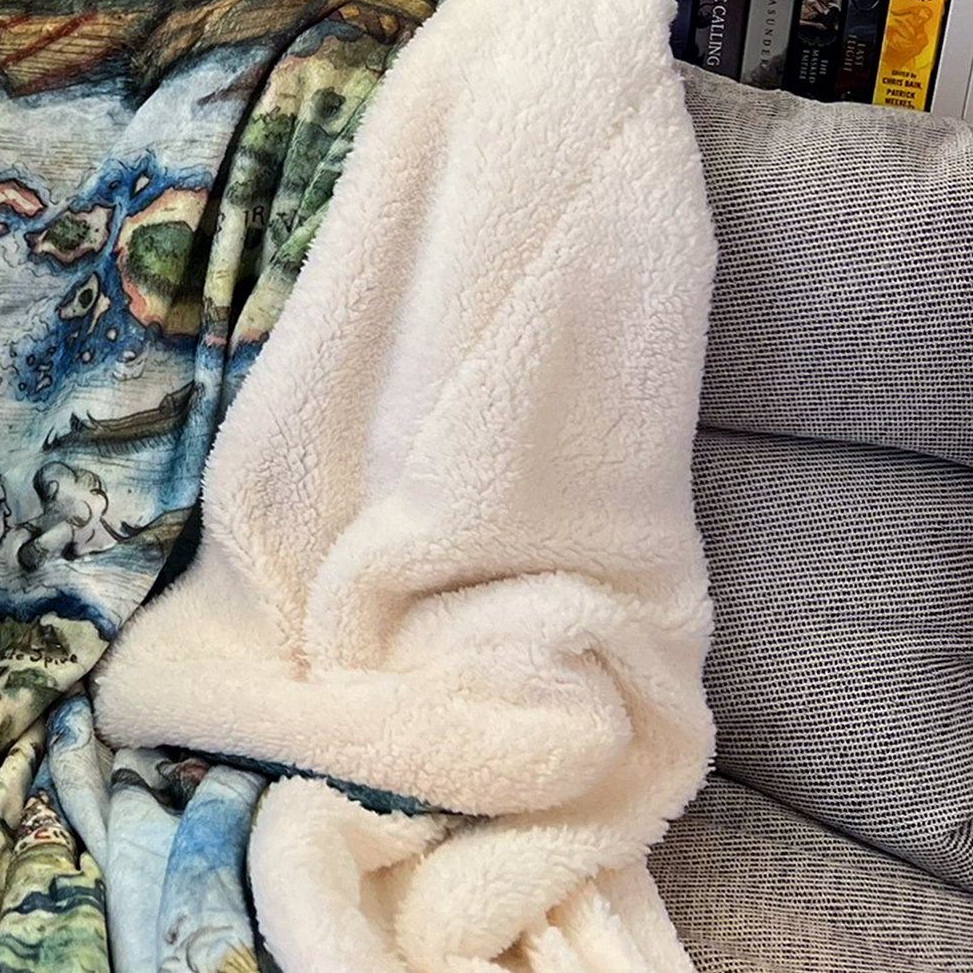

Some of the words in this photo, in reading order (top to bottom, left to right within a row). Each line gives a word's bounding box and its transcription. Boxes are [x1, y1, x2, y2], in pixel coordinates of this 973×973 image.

[707, 4, 726, 67] CALLING
[843, 34, 857, 72] FLIGHT
[855, 43, 867, 67] LAST
[883, 77, 903, 86] CHRIS
[887, 89, 915, 99] PATRICK
